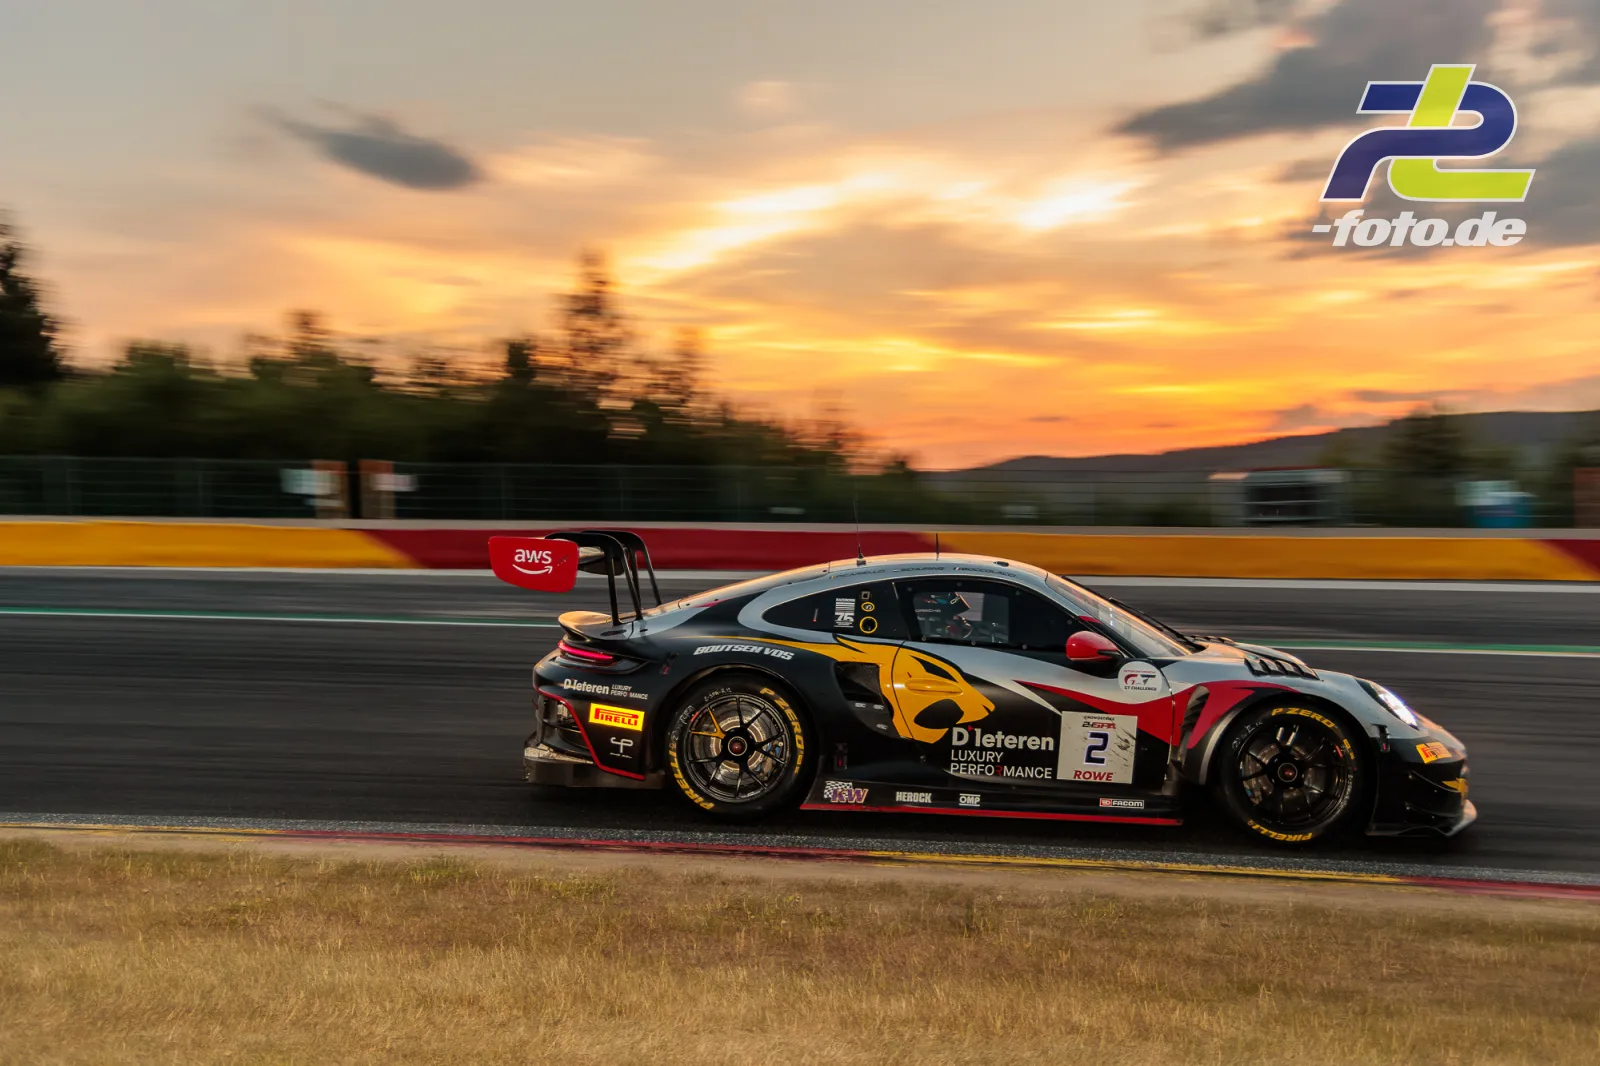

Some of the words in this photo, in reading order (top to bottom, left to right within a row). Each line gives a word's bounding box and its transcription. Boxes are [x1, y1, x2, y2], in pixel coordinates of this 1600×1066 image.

[514, 548, 552, 564] aws
[693, 645, 764, 656] BOUTSEN
[763, 647, 796, 661] VDS
[612, 683, 633, 692] LUXURY
[594, 707, 639, 727] PIRELLI
[951, 749, 1004, 763] LUXURY
[1083, 730, 1109, 766] 2
[669, 749, 715, 810] PIRELLI
[1073, 769, 1114, 782] ROWE
[831, 787, 869, 804] KW
[895, 790, 932, 803] HEROCK
[959, 795, 981, 805] OMP
[1251, 823, 1313, 842] PIRELLI
